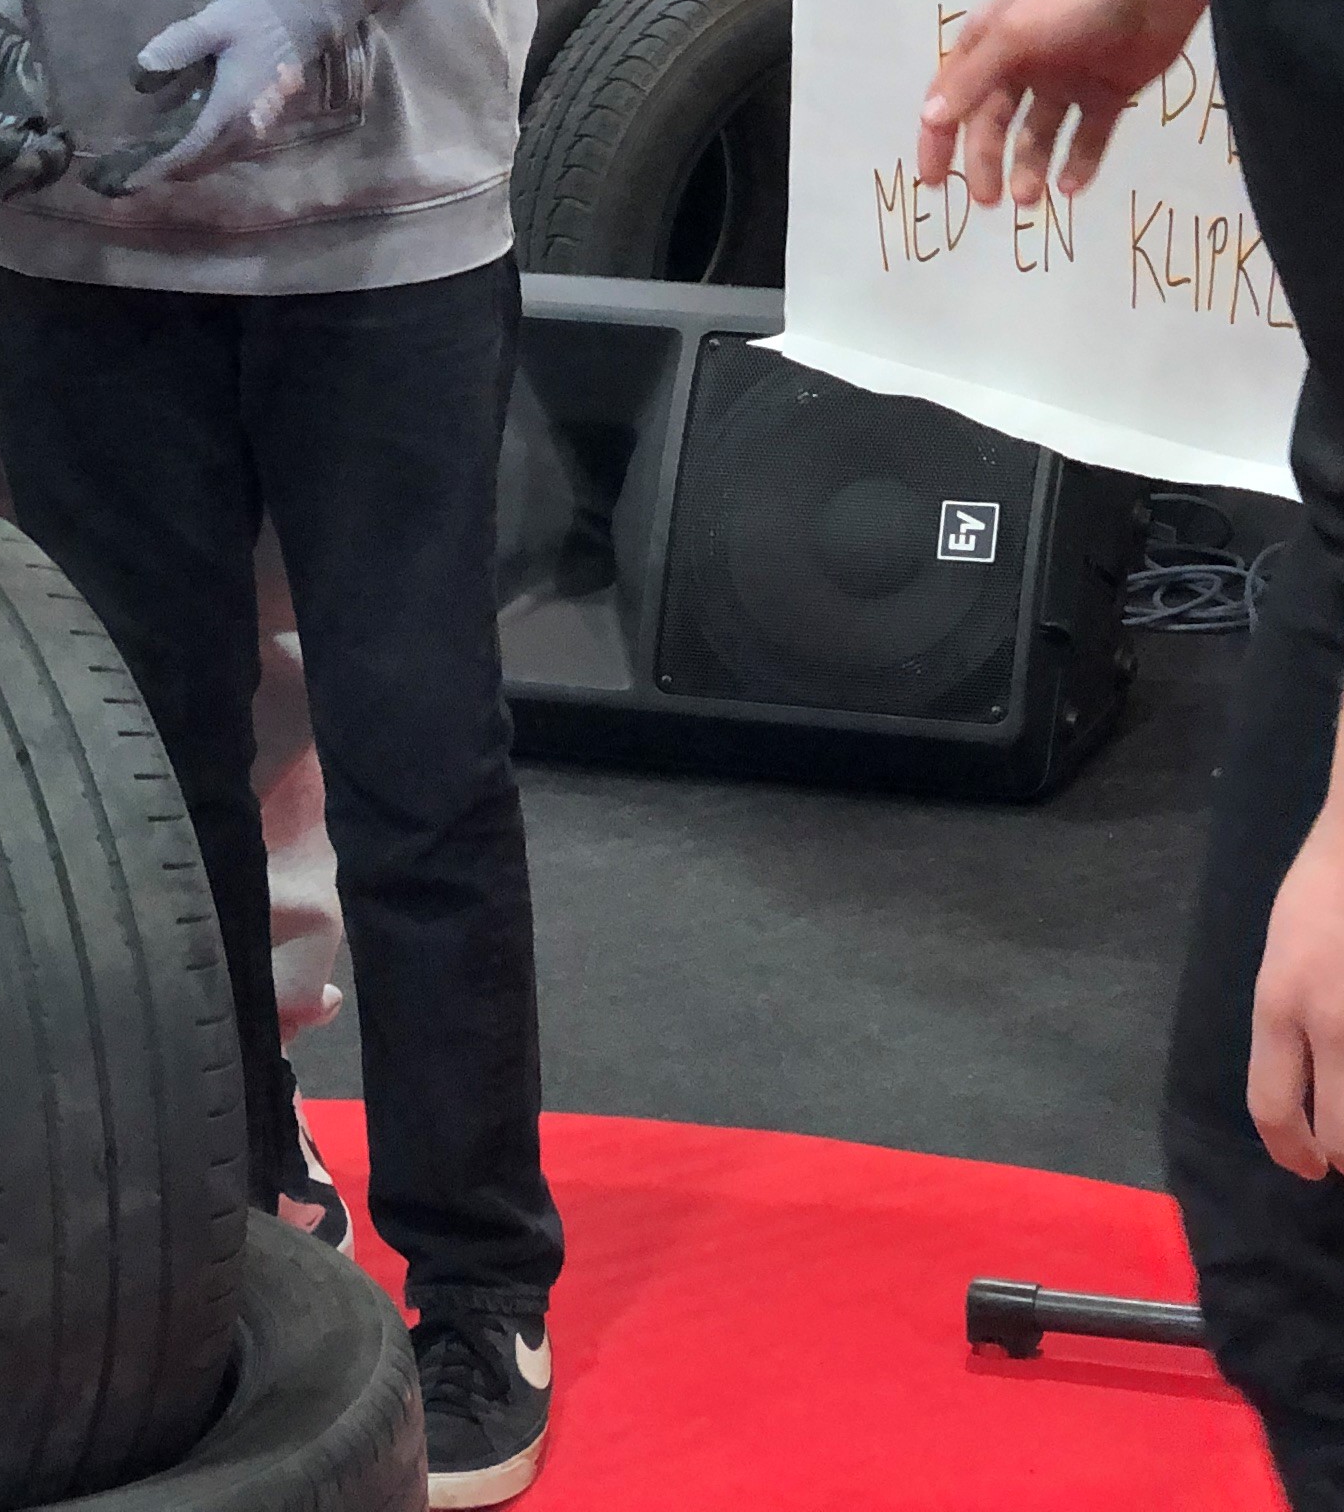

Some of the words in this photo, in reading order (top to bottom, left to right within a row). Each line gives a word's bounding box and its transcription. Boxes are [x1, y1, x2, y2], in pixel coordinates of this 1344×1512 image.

[872, 157, 972, 272] MED
[1013, 180, 1075, 273] EN
[1130, 189, 1296, 329] KLIPKL
